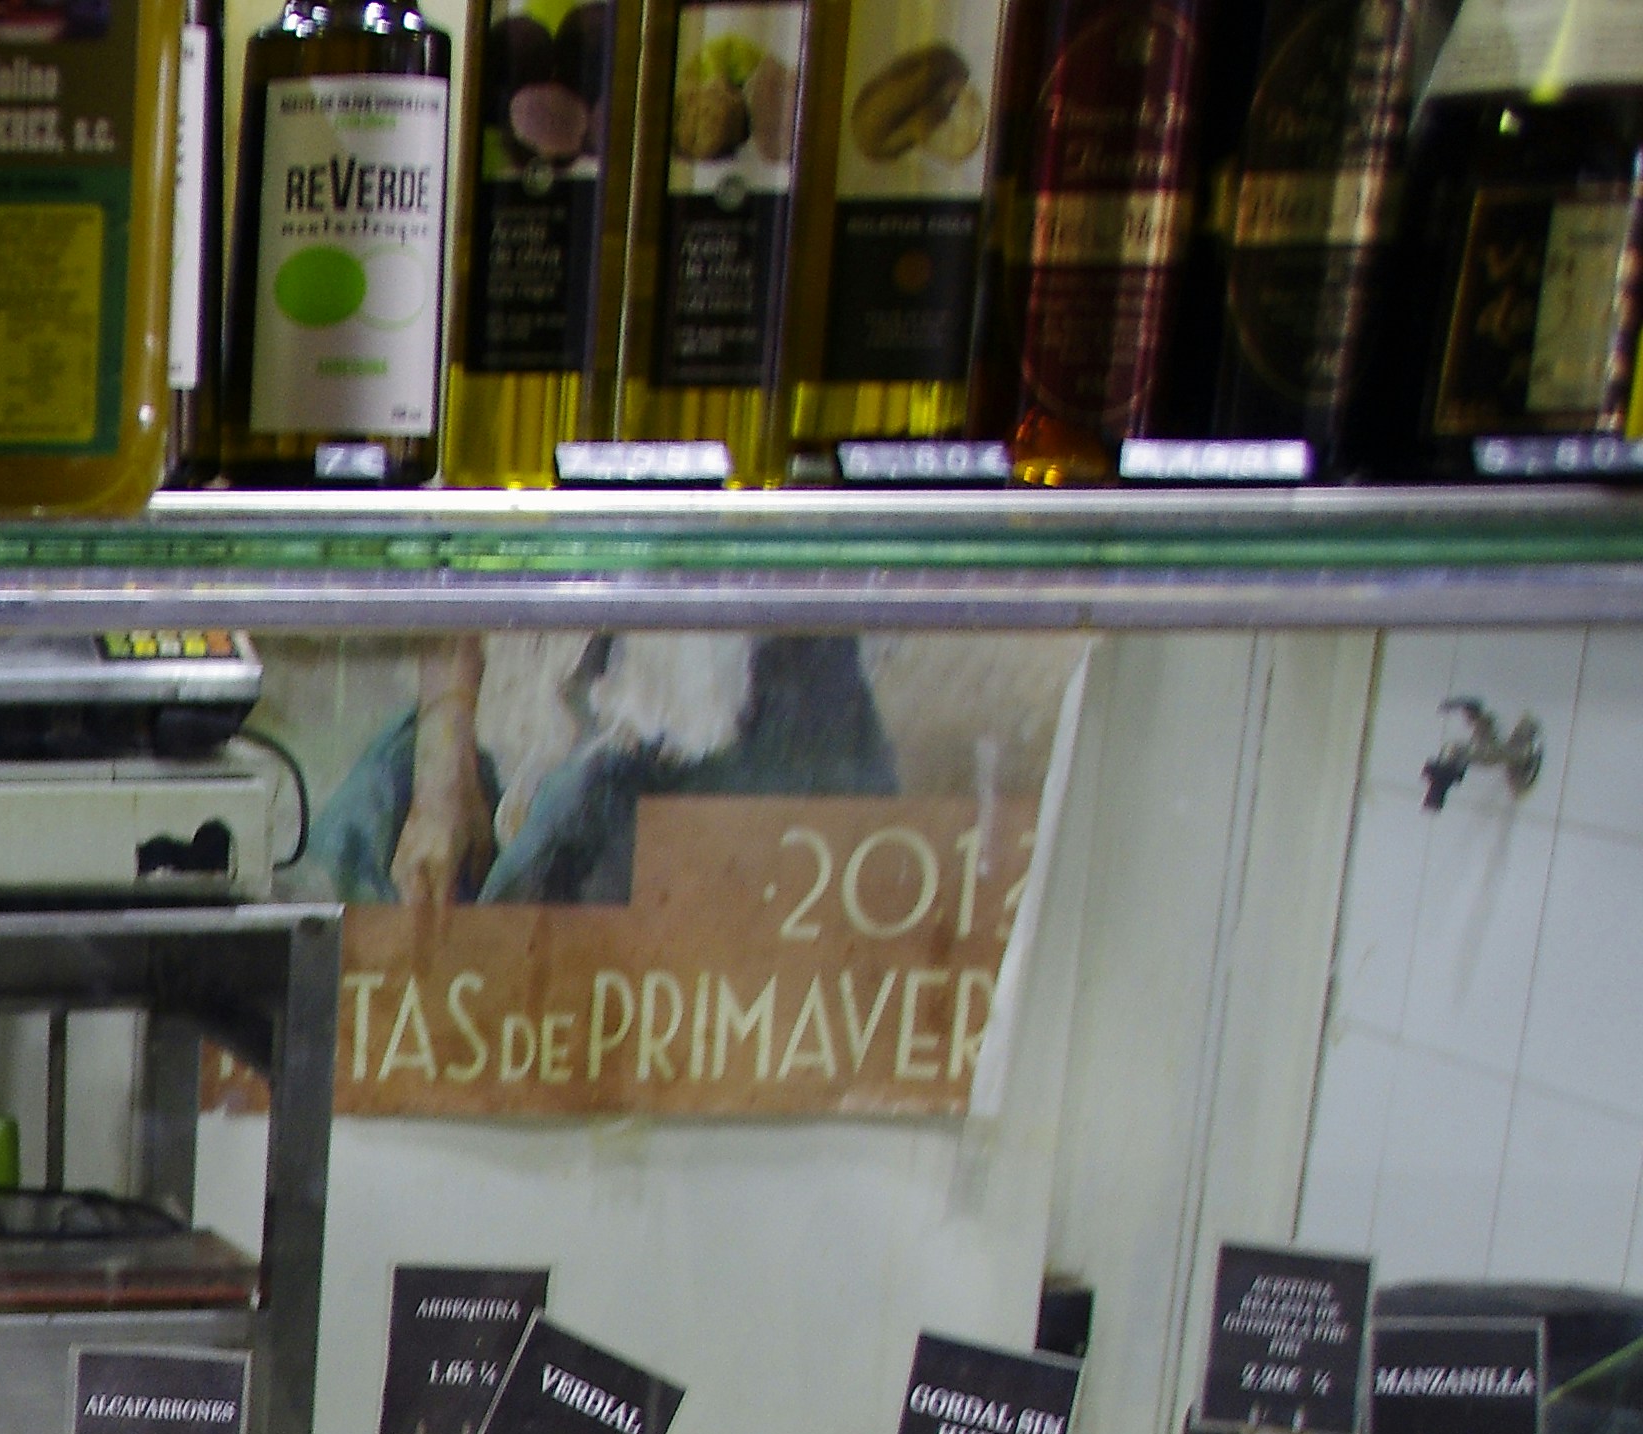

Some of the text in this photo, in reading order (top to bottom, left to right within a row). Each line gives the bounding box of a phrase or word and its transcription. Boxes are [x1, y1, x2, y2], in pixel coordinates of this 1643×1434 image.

[500, 1013, 574, 1083] DE
[588, 968, 998, 1083] PRIMAVER
[1374, 1365, 1538, 1396] MANZANILLA
[83, 1393, 238, 1424] ALCAPARRONES
[909, 1381, 1017, 1434] GORDAL
